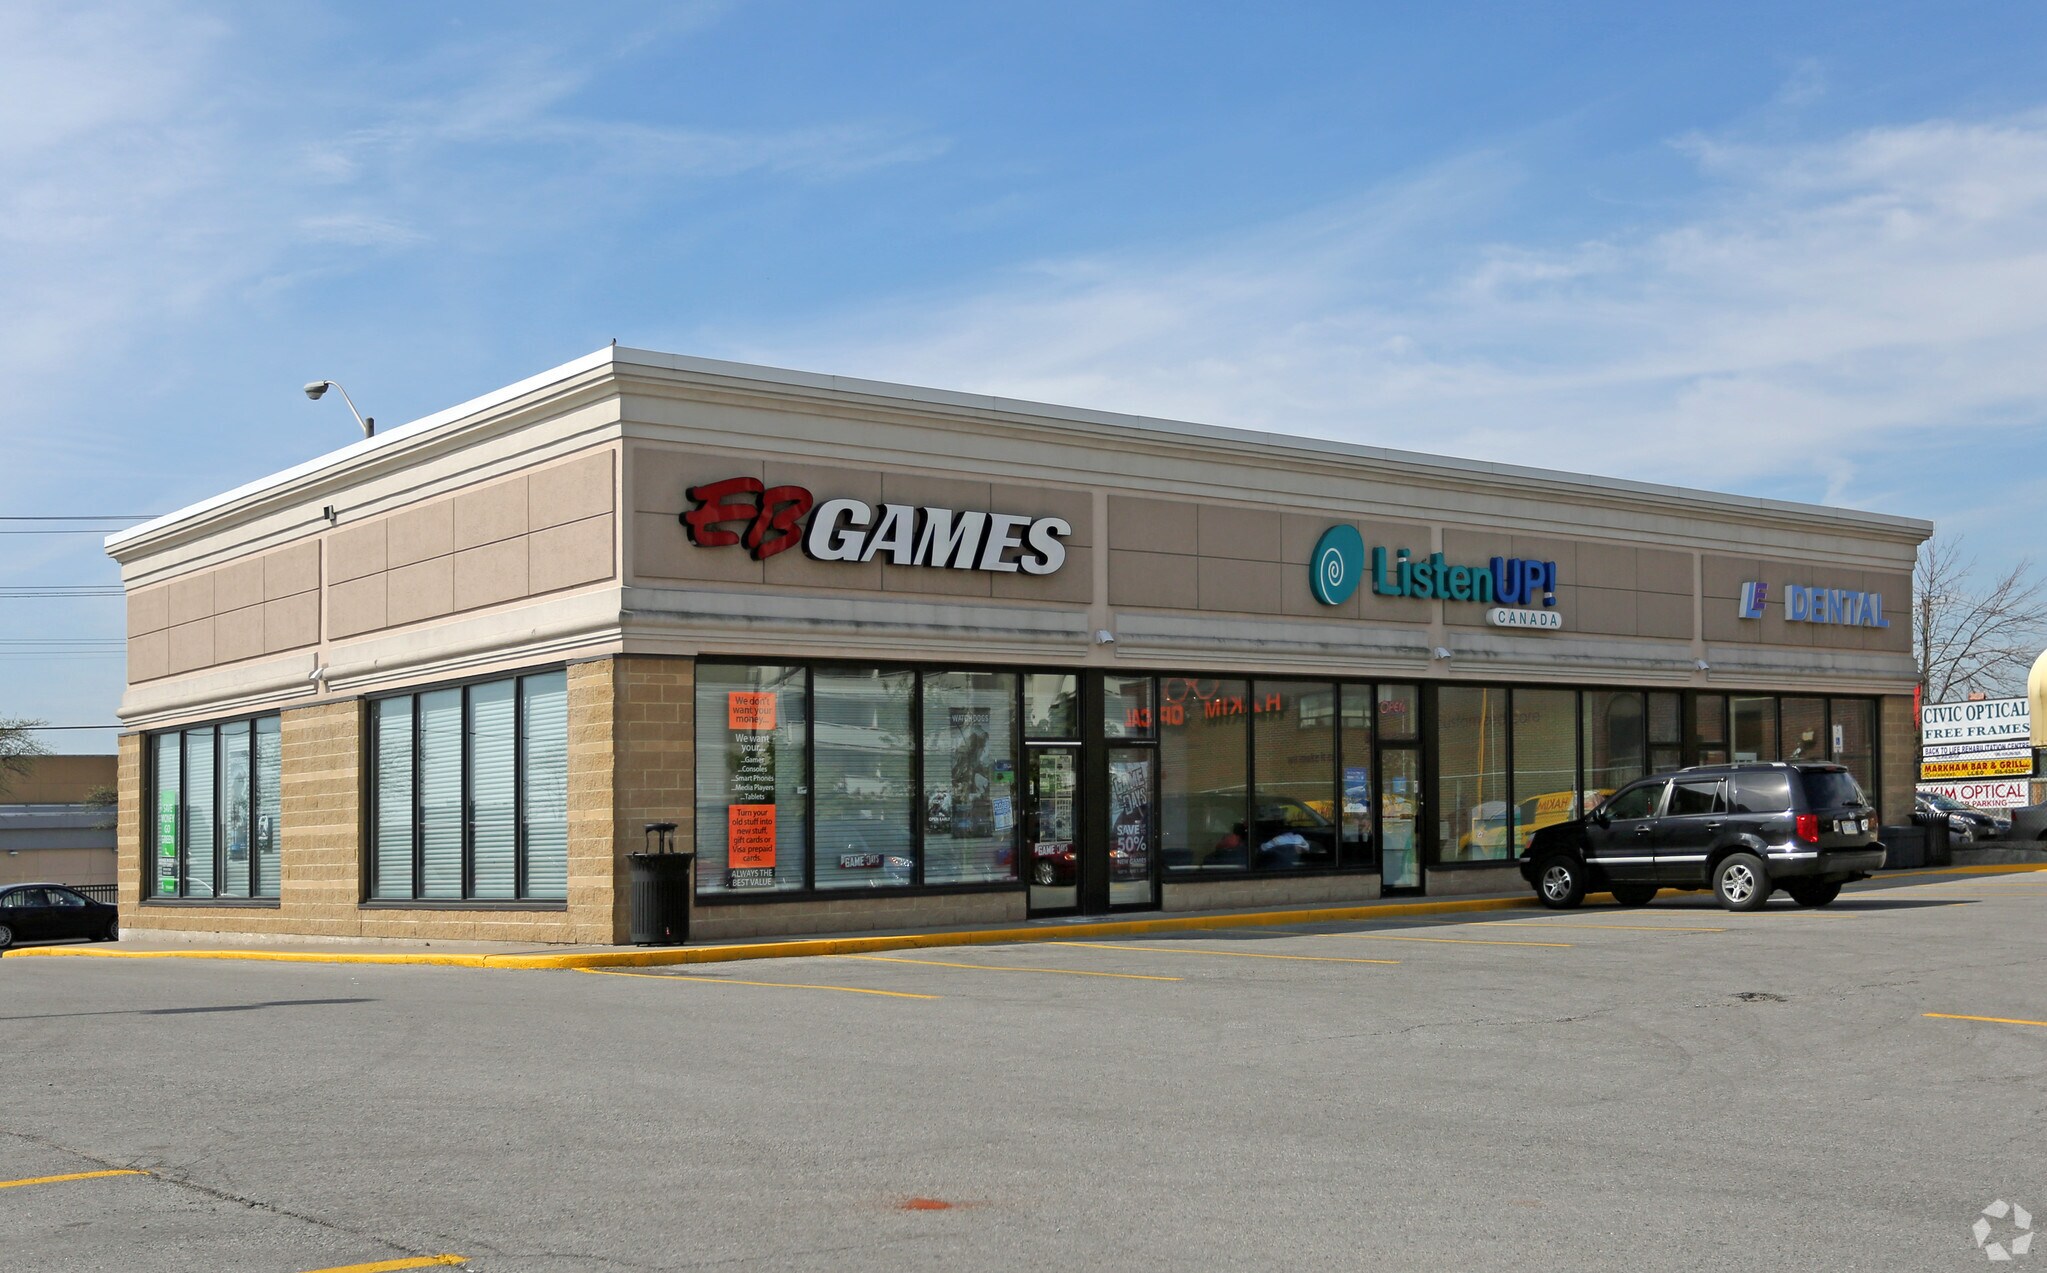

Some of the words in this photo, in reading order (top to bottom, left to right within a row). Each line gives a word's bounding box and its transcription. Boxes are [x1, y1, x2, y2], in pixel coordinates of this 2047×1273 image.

[679, 476, 814, 561] EB
[802, 498, 1073, 575] GAMES
[1785, 584, 1889, 628] DENTAL
[1498, 610, 1557, 627] CANADA
[735, 696, 748, 705] We
[749, 696, 770, 705] don't
[754, 707, 772, 715] your
[1924, 705, 1963, 724] CIVIC
[1965, 701, 2029, 721] OPTICAL
[1925, 728, 1963, 739] FREE
[1967, 722, 2030, 737] FRAMES
[735, 733, 748, 742] We
[749, 734, 770, 742] want
[1925, 747, 1940, 755] BACK
[1949, 745, 1960, 753] LIFE
[1961, 743, 2006, 752] REHABILITATION
[2007, 741, 2029, 749] CENTRE
[1924, 762, 1969, 773] MARKHAM
[1970, 761, 1988, 771] BAR
[1990, 761, 1997, 769] &
[754, 784, 774, 792] Players
[1961, 783, 2024, 800] OPTICAL
[1972, 799, 2007, 807] PARKING
[753, 810, 768, 818] your
[1117, 824, 1140, 836] SAVE
[734, 837, 745, 845] gift
[1117, 836, 1147, 852] 50%
[732, 845, 746, 853] Visa
[747, 845, 773, 854] prepaid
[732, 869, 759, 877] ALWAYS
[732, 878, 751, 887] BEST
[751, 878, 772, 886] VALUE
